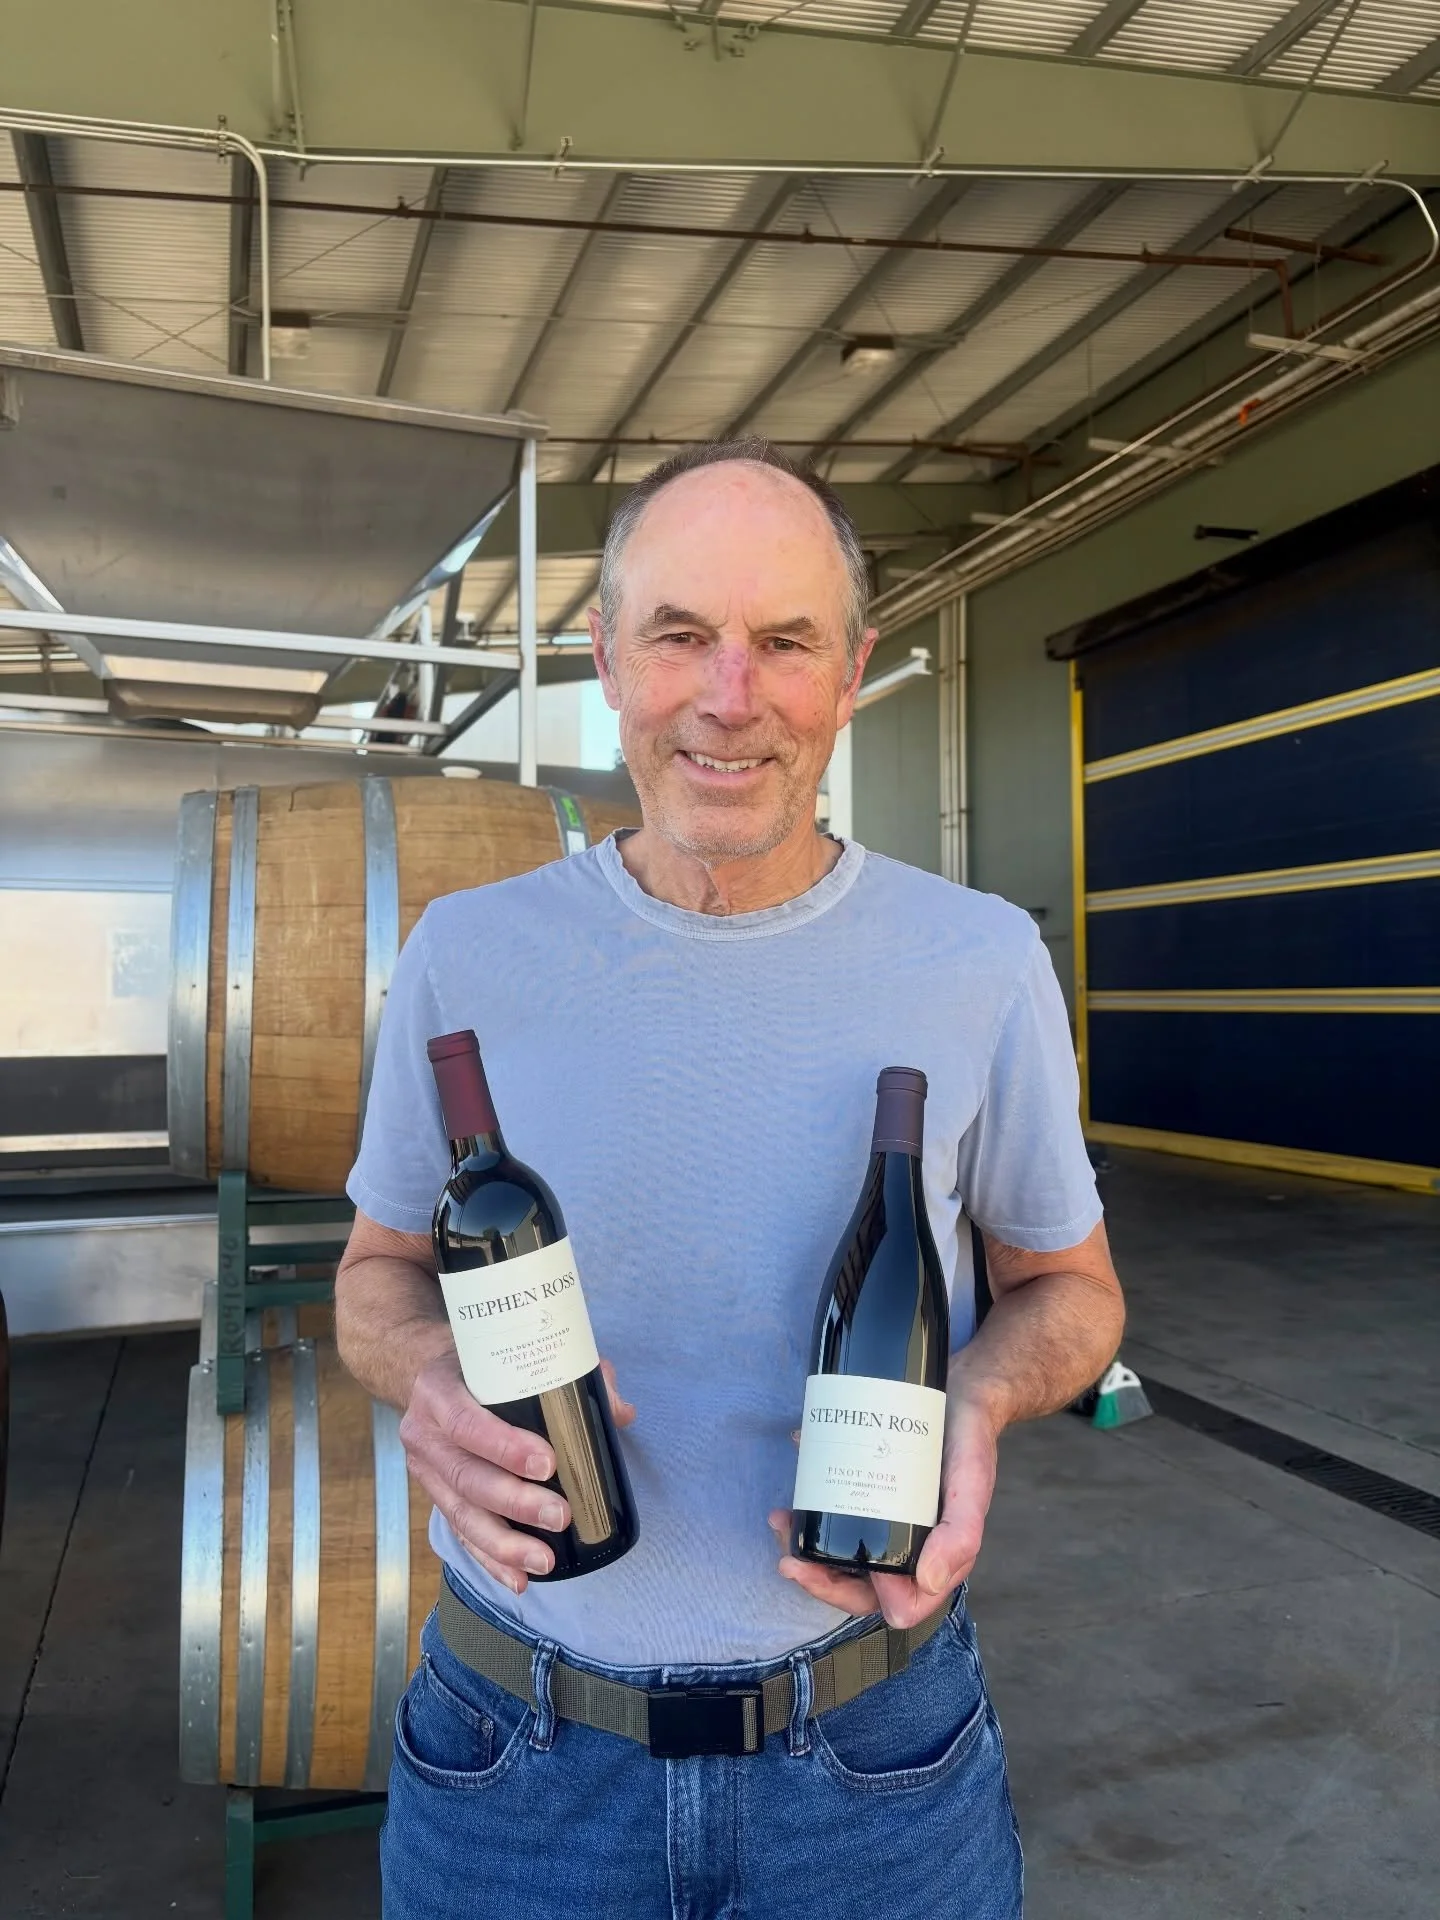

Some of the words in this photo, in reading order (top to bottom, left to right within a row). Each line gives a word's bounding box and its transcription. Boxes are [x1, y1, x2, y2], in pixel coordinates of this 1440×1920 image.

[458, 1287, 537, 1321] STEPHEN
[541, 1272, 576, 1299] ROSS
[490, 1347, 514, 1357] DANTE
[536, 1327, 571, 1344] VINEYARD
[501, 1338, 567, 1365] ZINFANDEL
[810, 1408, 885, 1428] STEPHEN
[888, 1416, 929, 1436] ROSS
[827, 1466, 862, 1478] PINOT
[867, 1471, 897, 1483] NOIR
